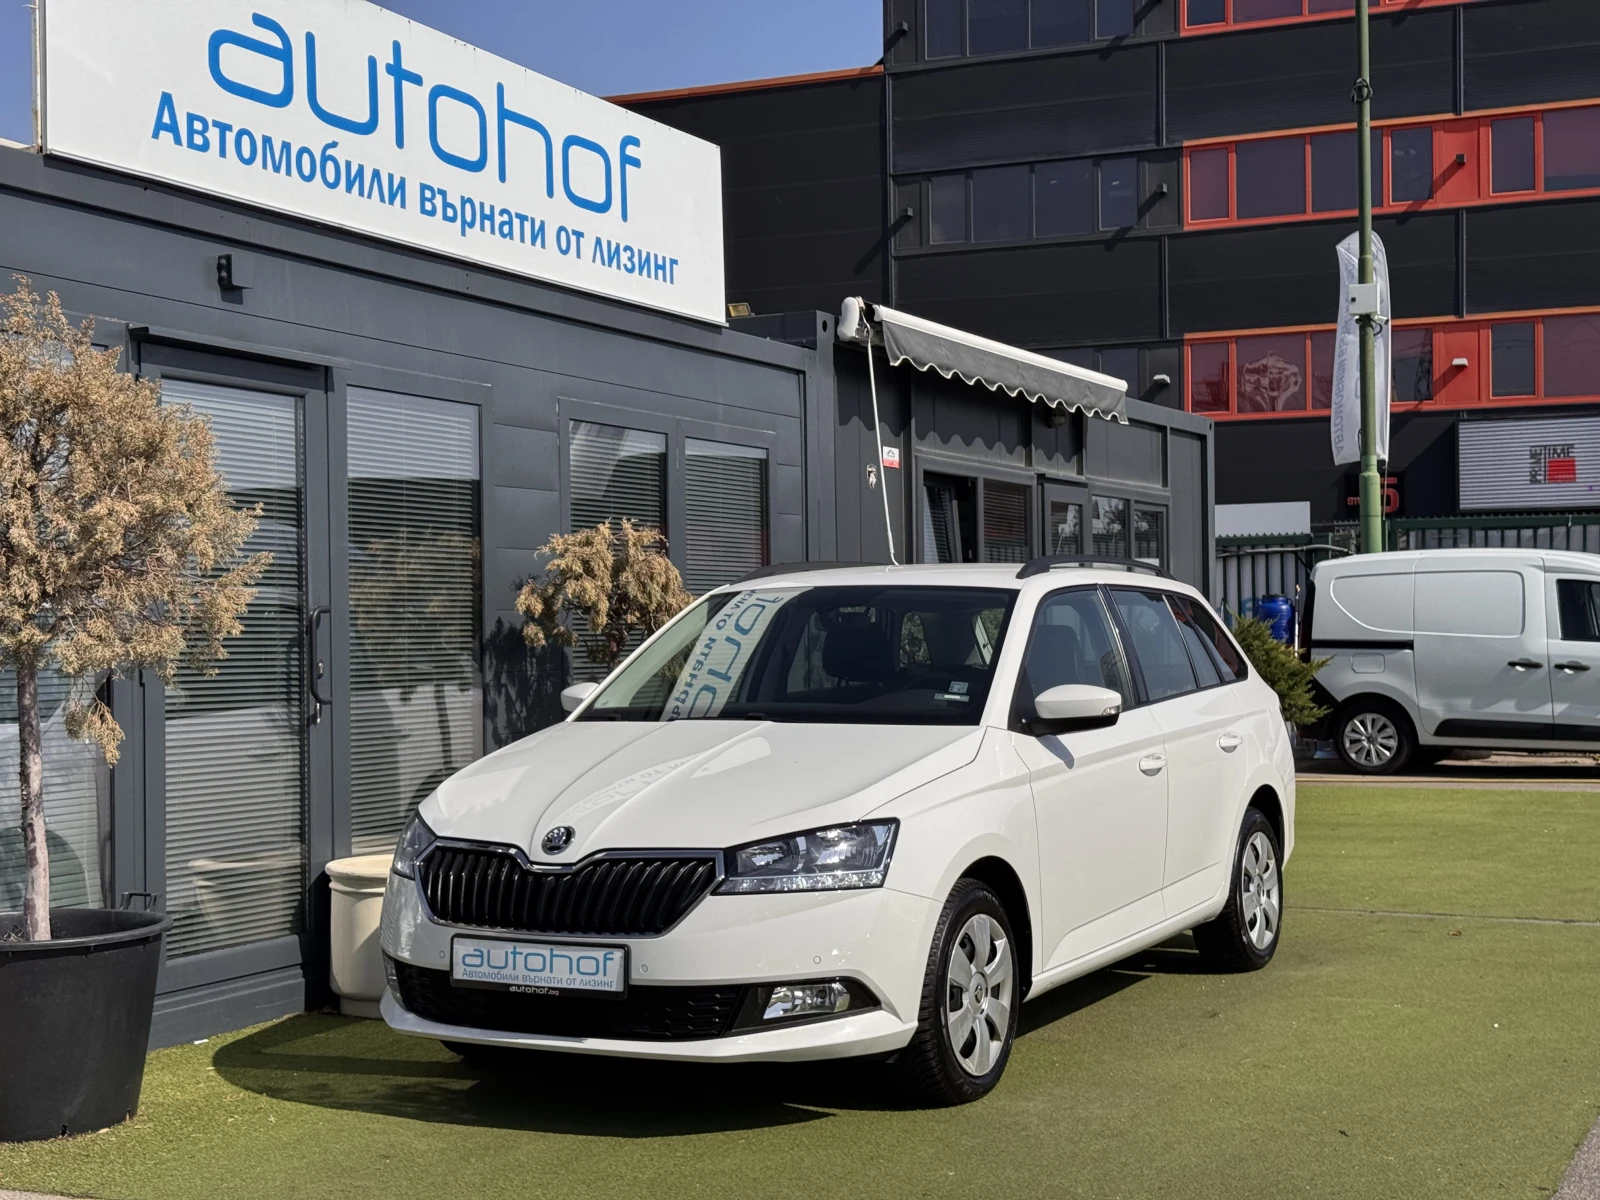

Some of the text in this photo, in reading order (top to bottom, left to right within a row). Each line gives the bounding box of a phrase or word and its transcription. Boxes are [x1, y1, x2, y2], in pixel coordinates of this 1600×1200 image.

[208, 13, 641, 222] autohof
[151, 91, 679, 285] Автомобили върнати от лизинг
[461, 945, 615, 977] autohof
[462, 967, 615, 989] Автомобили върнати от лизинг
[509, 985, 560, 996] autohof.bg
